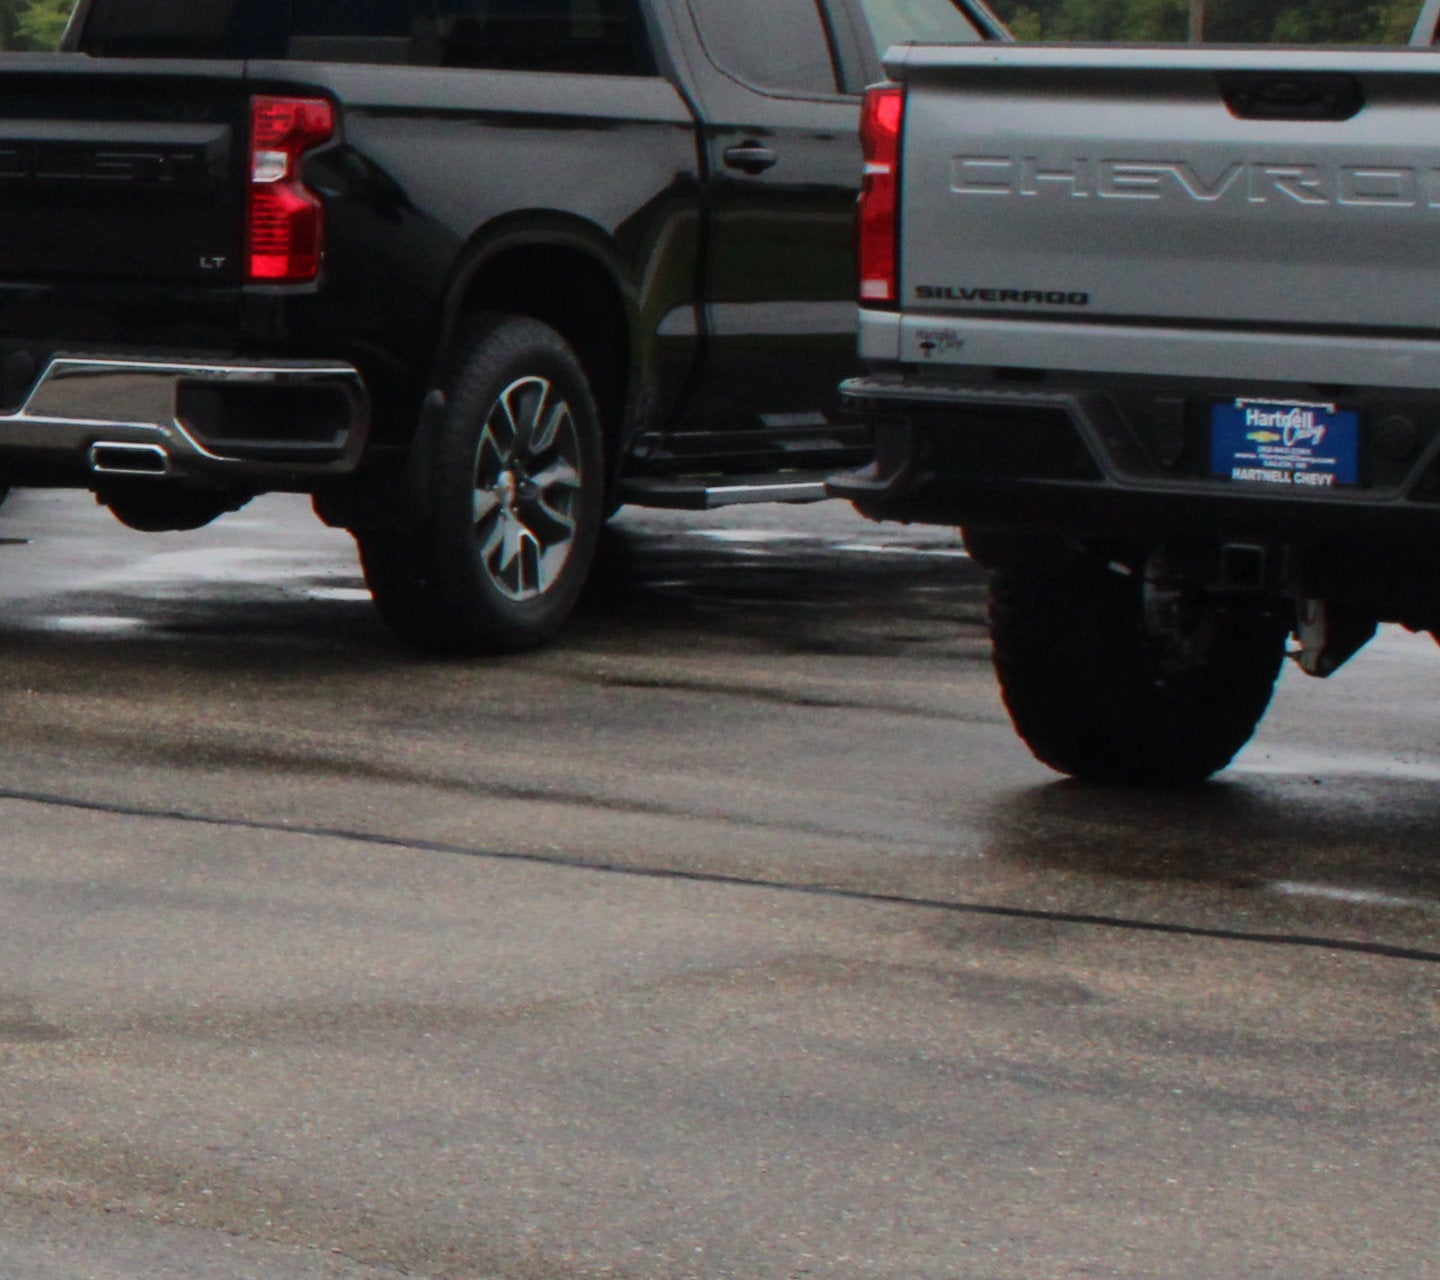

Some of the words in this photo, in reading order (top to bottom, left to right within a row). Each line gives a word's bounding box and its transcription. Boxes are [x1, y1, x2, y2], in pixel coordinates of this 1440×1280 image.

[950, 155, 1440, 208] CHEVRO
[200, 256, 226, 269] LT
[914, 285, 1089, 306] SILVERADO
[1245, 408, 1315, 428] Hartnell
[1231, 467, 1293, 484] HARTNELL
[1293, 471, 1335, 487] CHEVY
